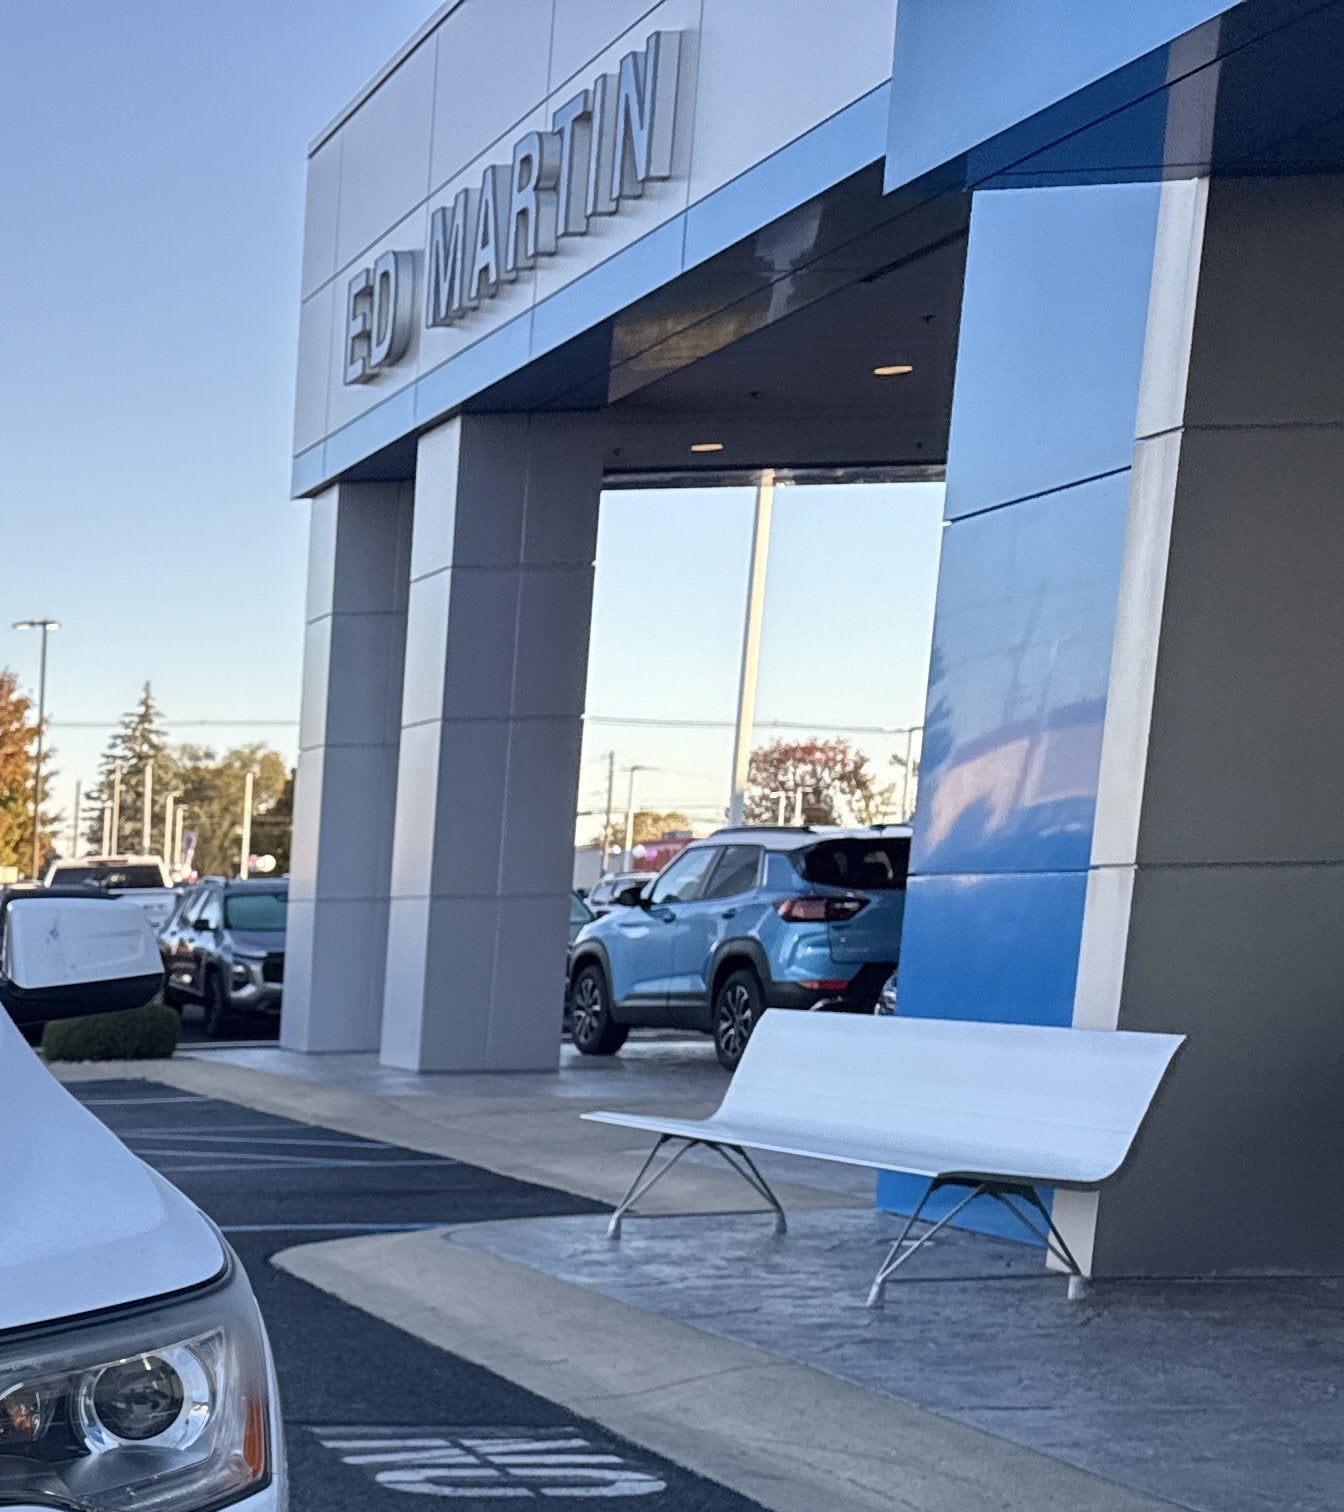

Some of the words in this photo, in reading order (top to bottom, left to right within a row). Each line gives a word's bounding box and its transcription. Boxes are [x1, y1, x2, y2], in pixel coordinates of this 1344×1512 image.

[343, 250, 416, 385] ED
[426, 30, 681, 328] MARTIN
[320, 1437, 667, 1497] NO
